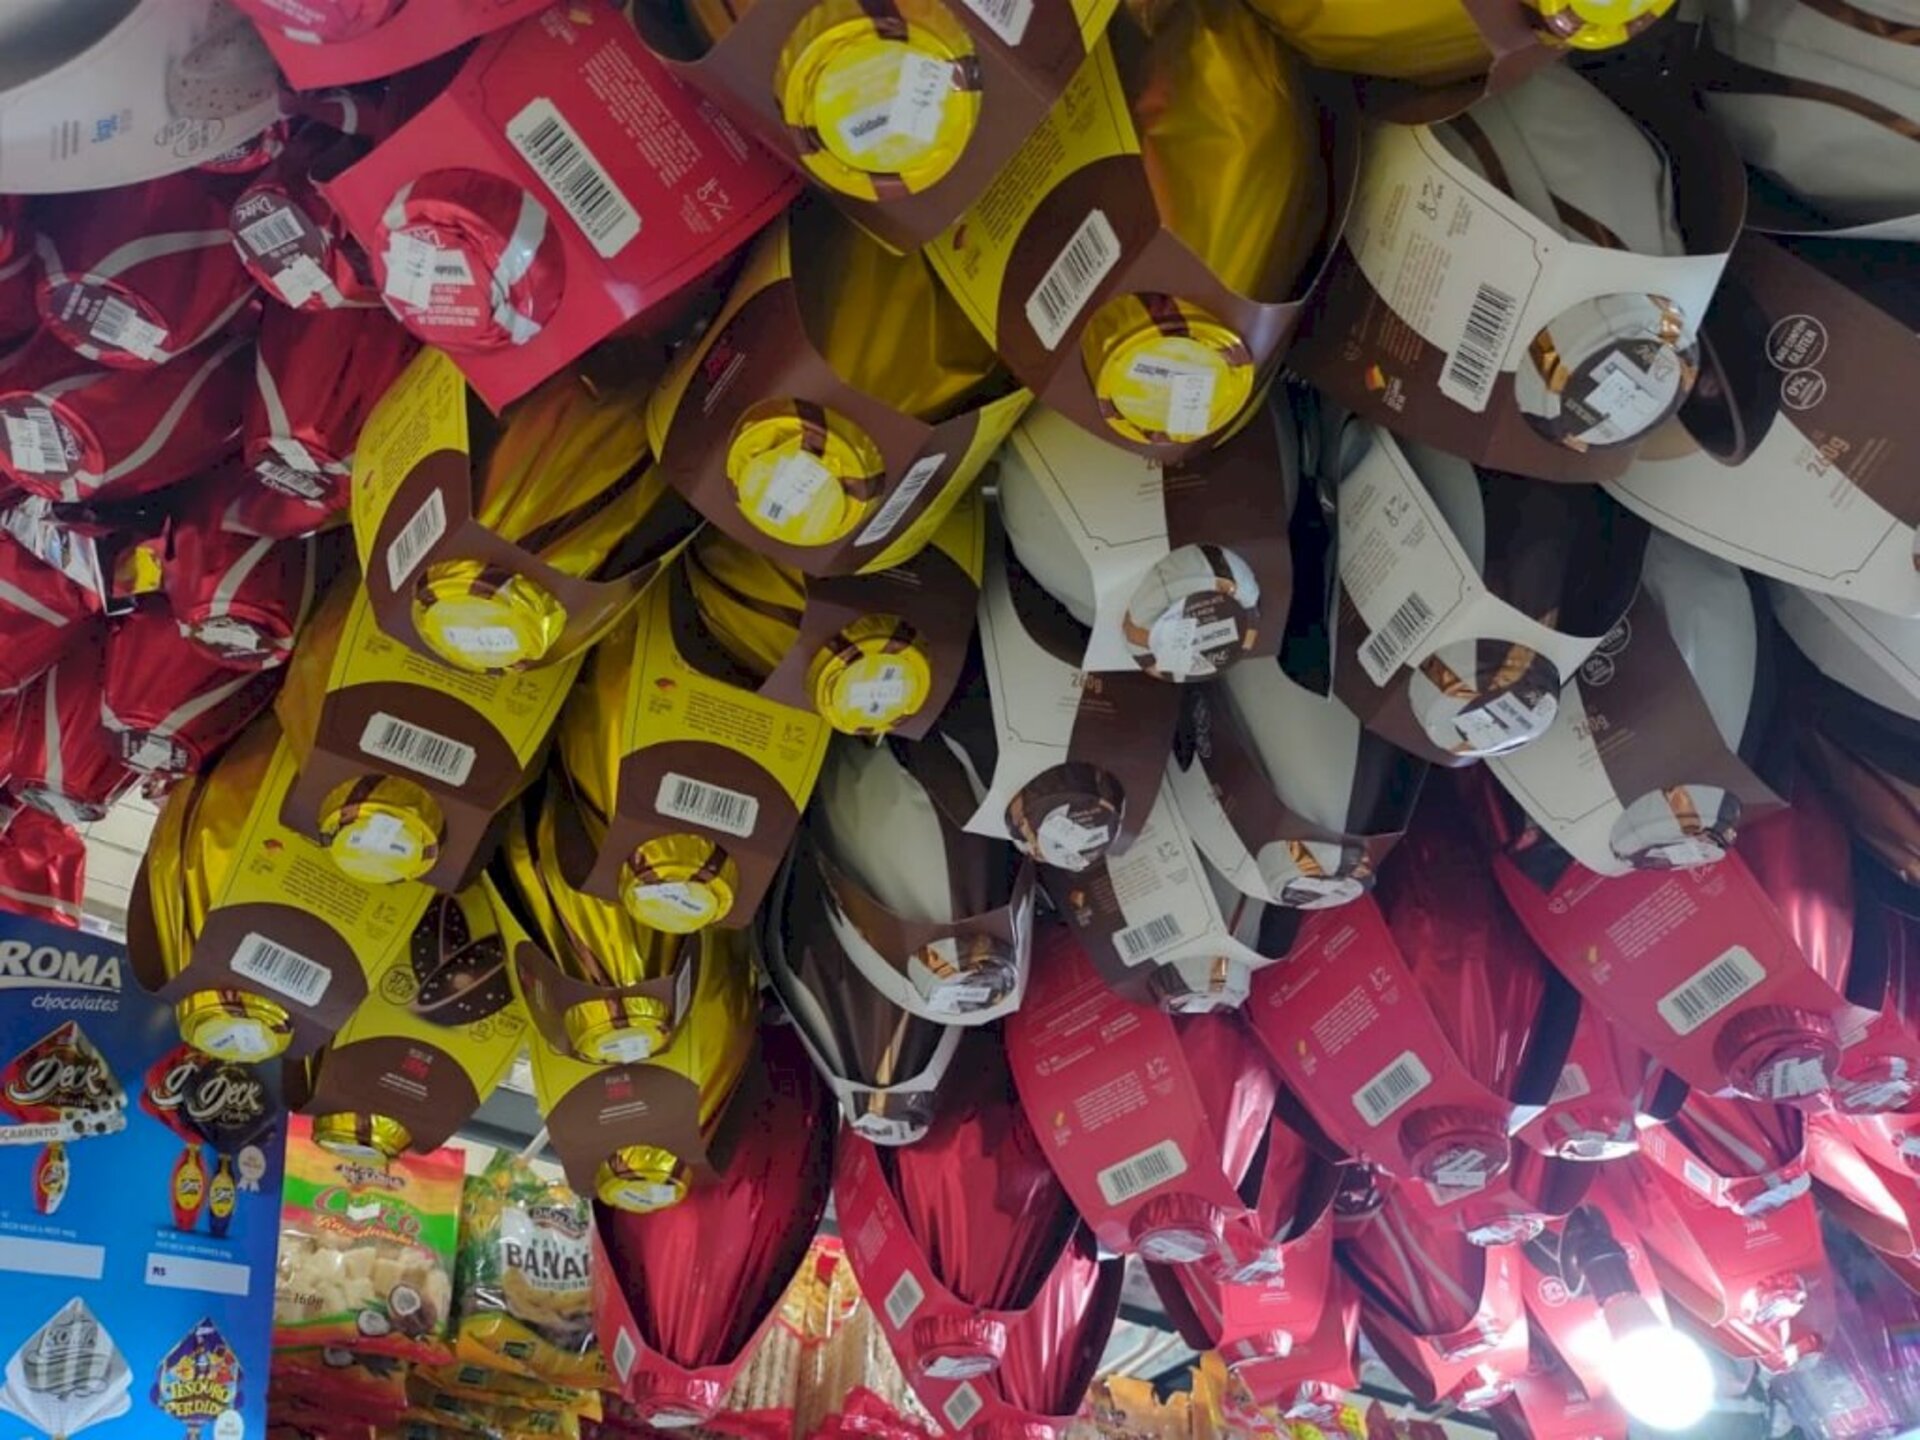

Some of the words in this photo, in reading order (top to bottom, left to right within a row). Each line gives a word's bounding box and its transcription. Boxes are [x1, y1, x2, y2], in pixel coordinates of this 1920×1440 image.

[0, 940, 122, 989] ROMA
[31, 993, 119, 1013] chocolates
[164, 1399, 222, 1417] PERDID
